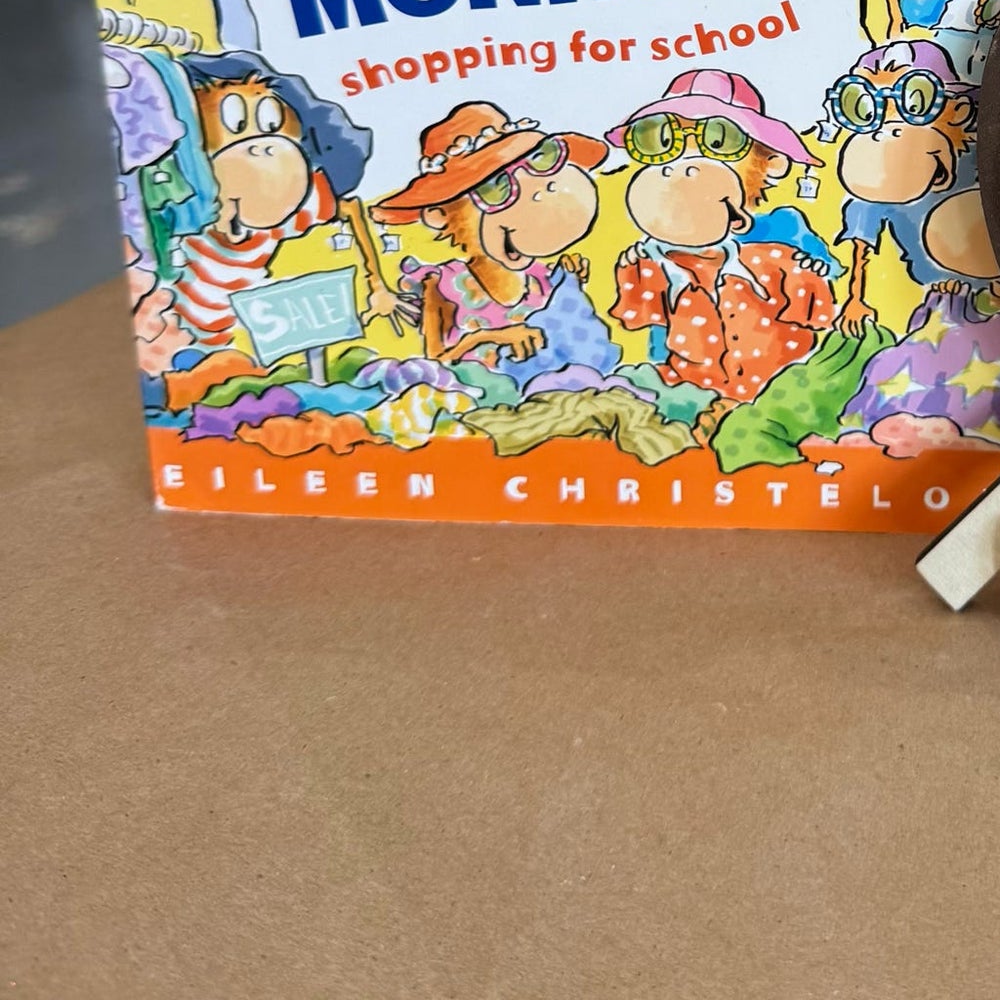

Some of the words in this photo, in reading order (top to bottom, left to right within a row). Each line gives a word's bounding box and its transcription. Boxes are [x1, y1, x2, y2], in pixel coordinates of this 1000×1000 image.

[341, 40, 556, 96] shopping
[570, 30, 636, 63] for
[650, 0, 799, 61] school
[162, 463, 435, 499] EILEEN
[503, 475, 987, 511] CHRISTELO
